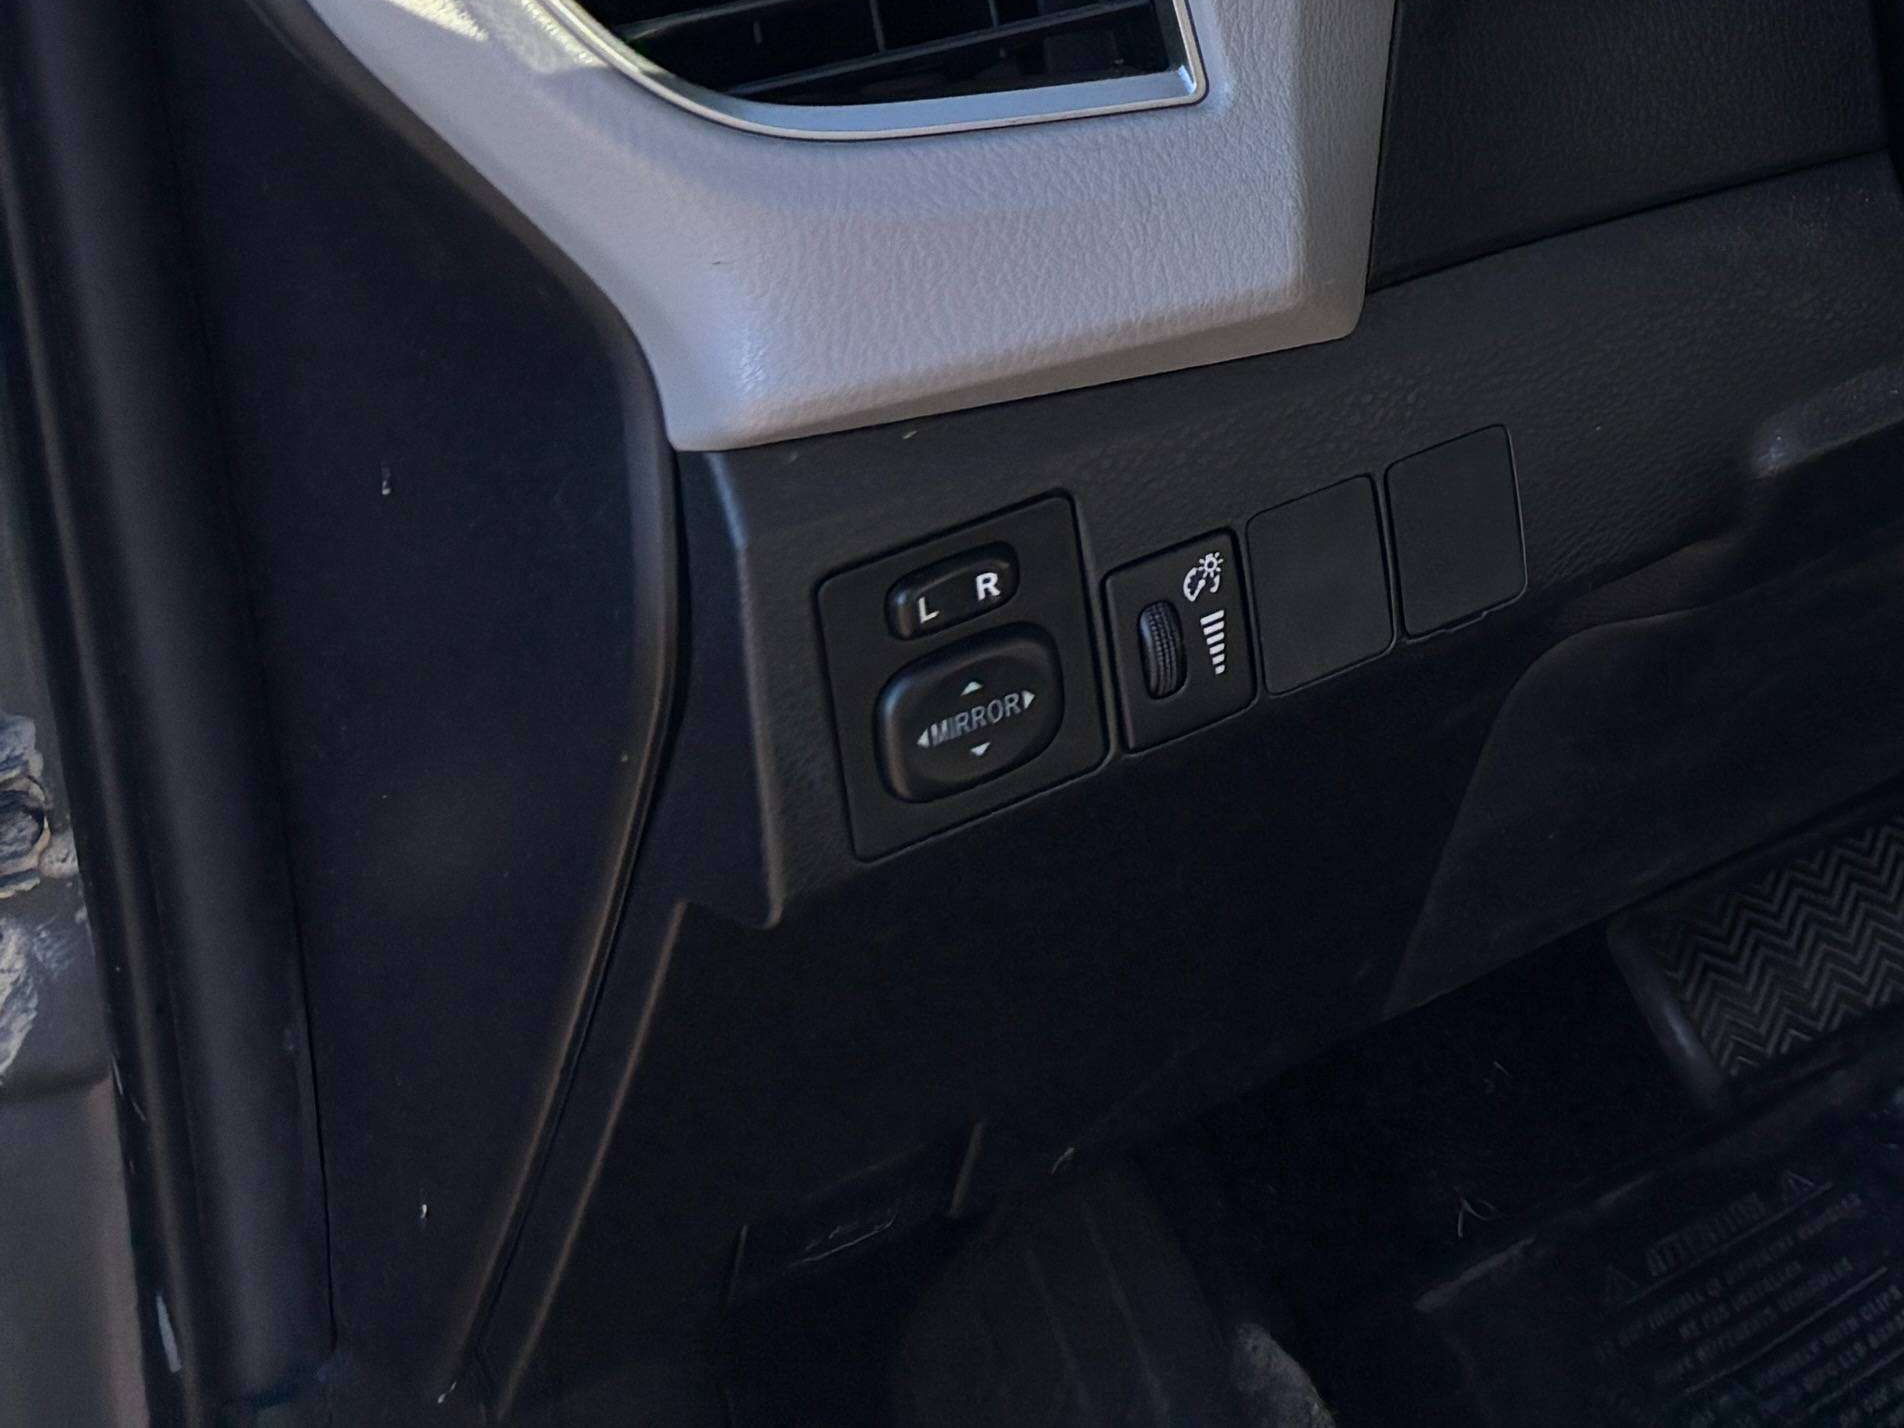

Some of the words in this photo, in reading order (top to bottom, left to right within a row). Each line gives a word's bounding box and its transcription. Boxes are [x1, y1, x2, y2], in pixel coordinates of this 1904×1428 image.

[918, 597, 940, 624] L
[976, 572, 1000, 601] R
[930, 693, 1021, 746] MIRROR
